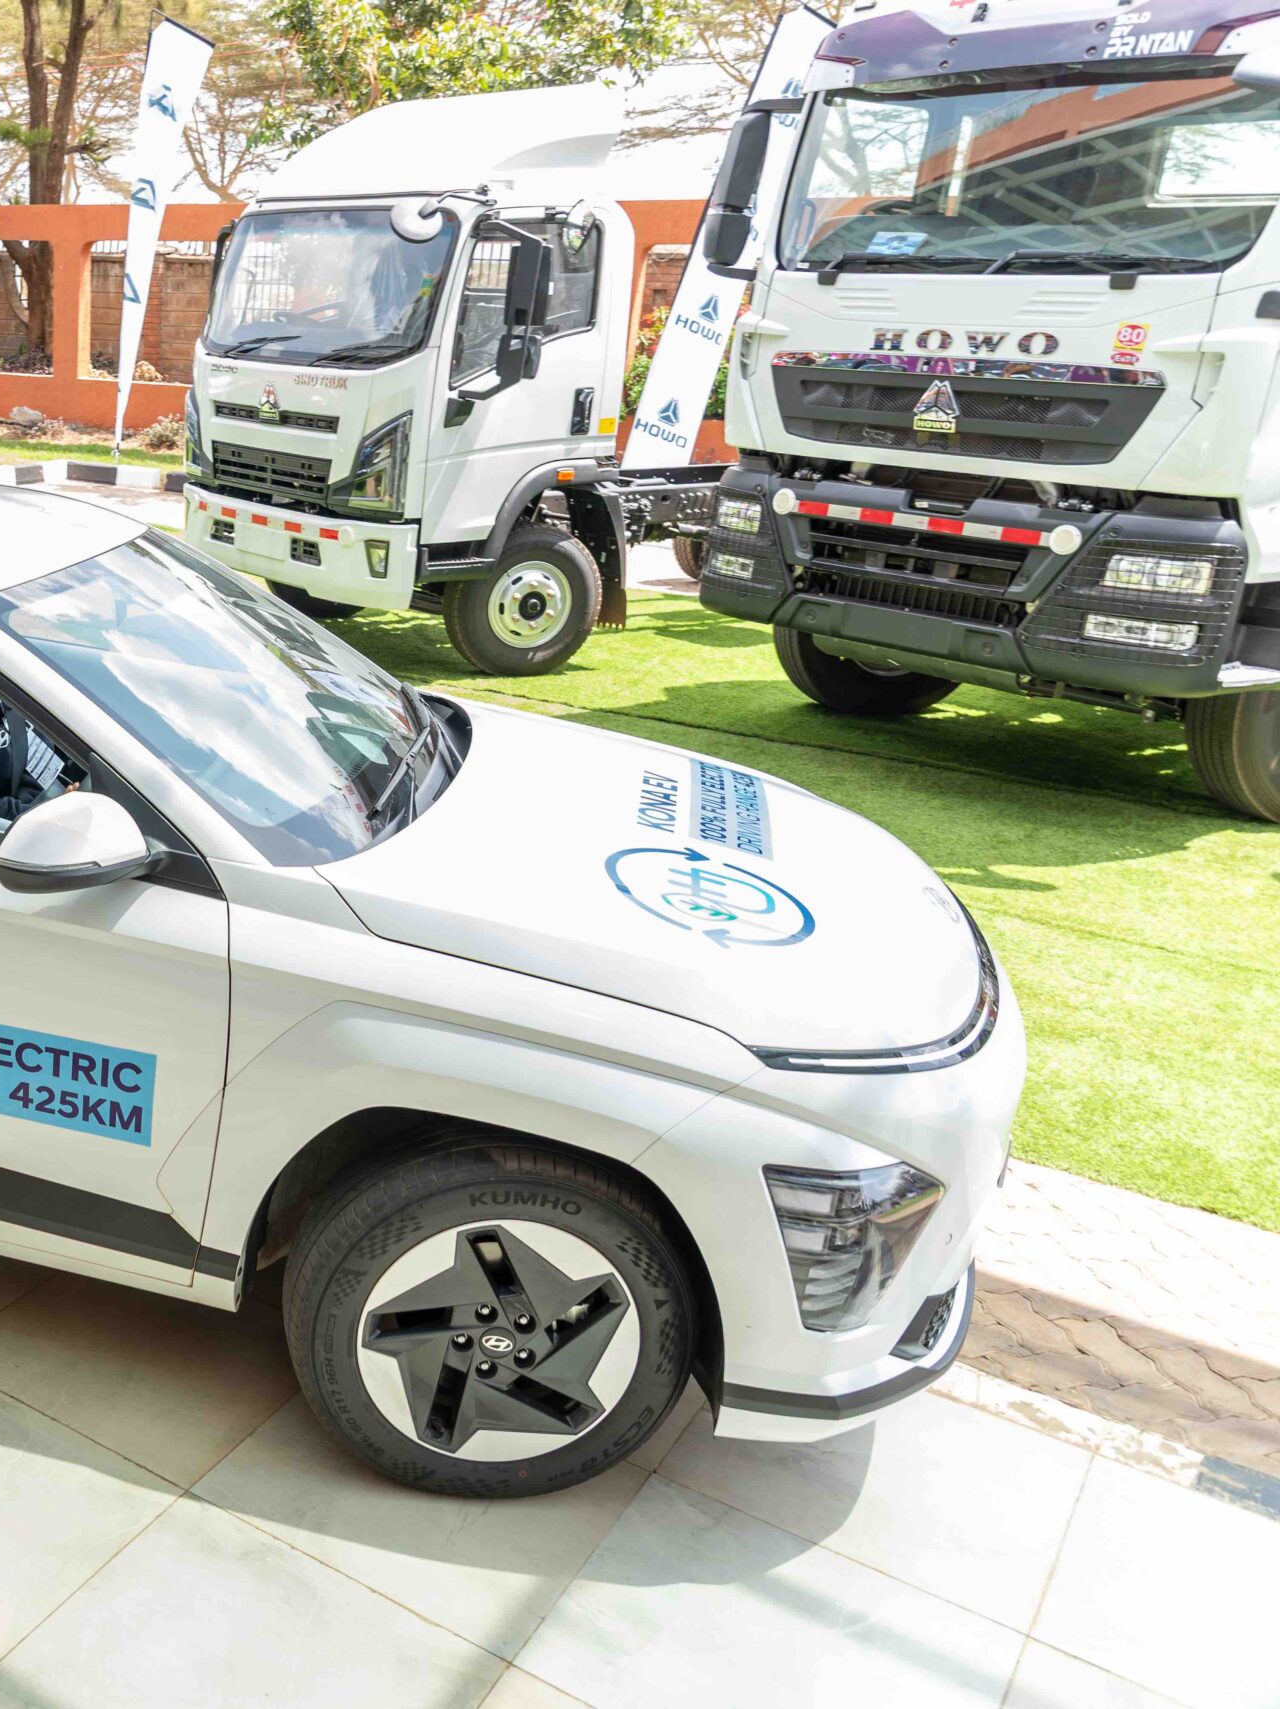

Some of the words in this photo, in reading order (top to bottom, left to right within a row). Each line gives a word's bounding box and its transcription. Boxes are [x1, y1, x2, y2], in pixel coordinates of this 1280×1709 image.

[1110, 25, 1134, 38] BY
[1114, 11, 1152, 26] SOLD
[870, 327, 1059, 357] HOWO
[1119, 326, 1145, 343] 80
[293, 373, 350, 390] SINOTRUK
[635, 417, 688, 449] HOWO
[917, 419, 951, 430] HOWO
[642, 770, 679, 792] EV
[637, 789, 677, 833] KONA
[700, 786, 727, 816] FULLY
[734, 786, 760, 813] RANGE
[700, 813, 727, 843] 100%
[736, 811, 763, 855] DRIVING
[8, 1081, 144, 1134] 425KM
[468, 1189, 583, 1217] KUMHO
